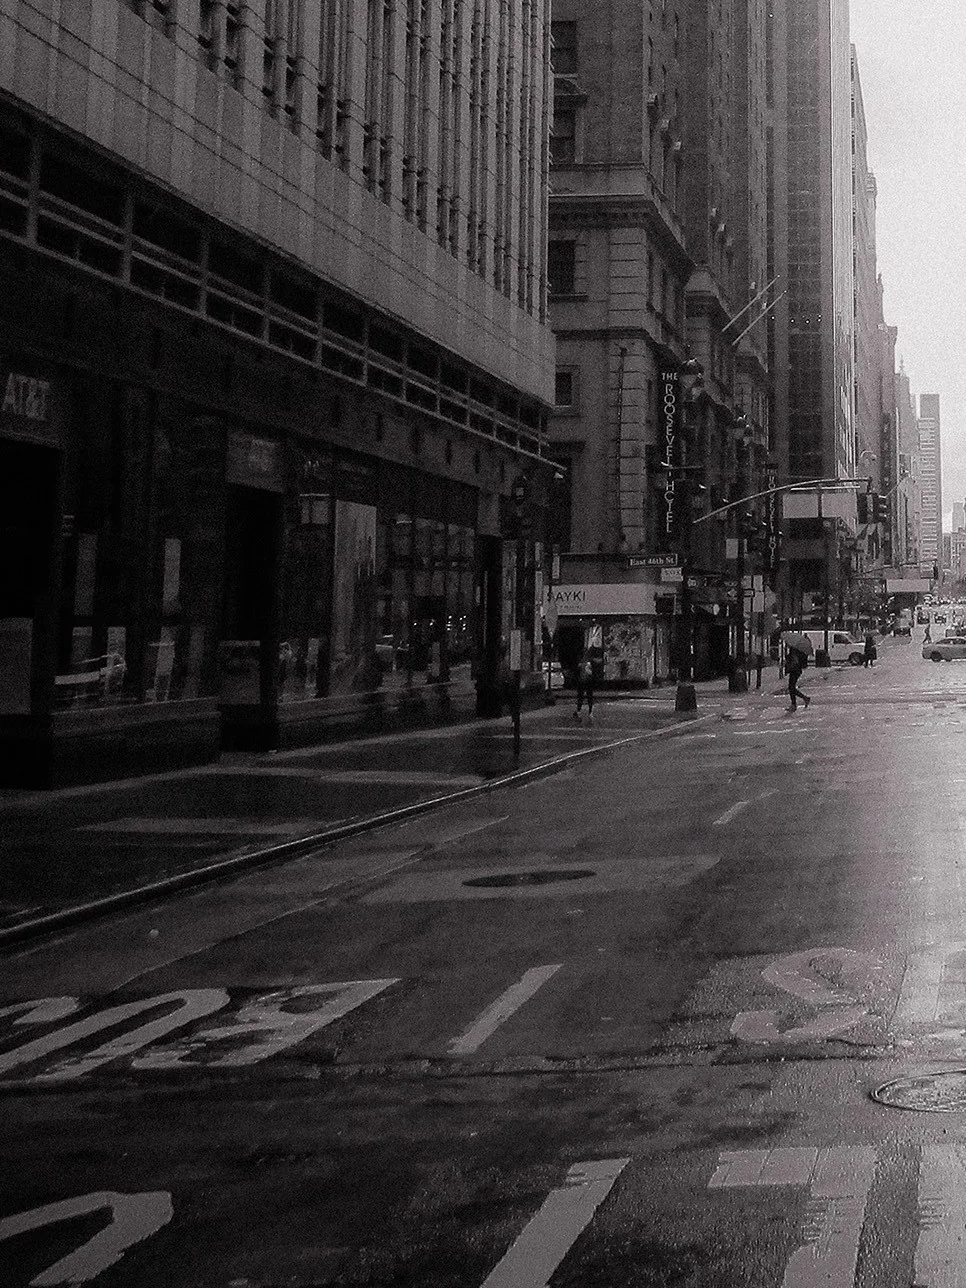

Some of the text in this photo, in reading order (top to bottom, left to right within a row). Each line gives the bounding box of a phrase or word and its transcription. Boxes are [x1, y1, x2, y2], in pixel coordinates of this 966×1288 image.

[661, 372, 678, 381] THE
[663, 480, 675, 533] HOTEL
[630, 558, 646, 566] East
